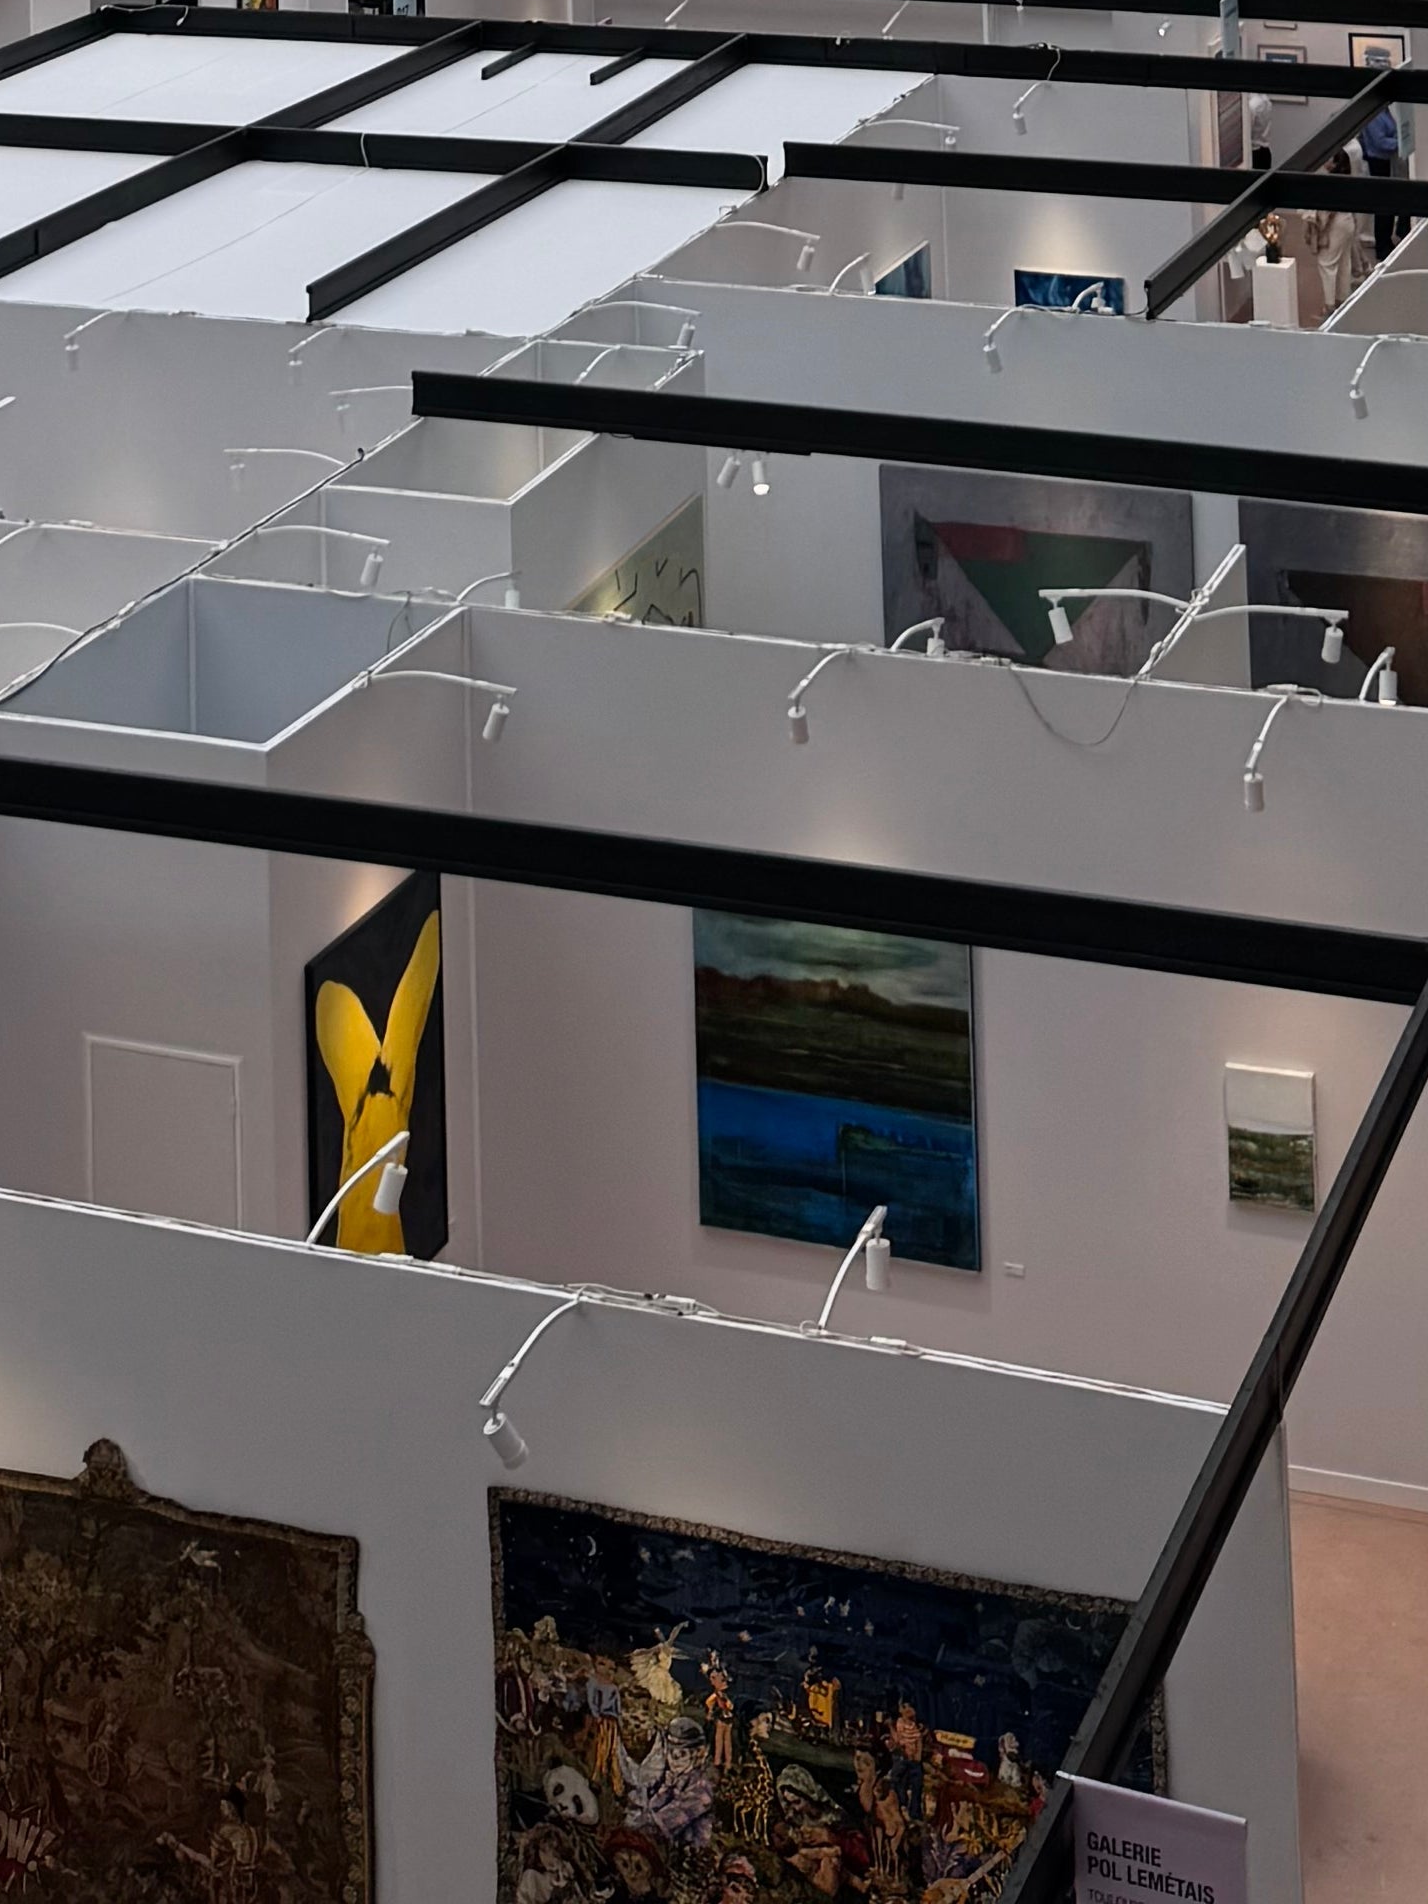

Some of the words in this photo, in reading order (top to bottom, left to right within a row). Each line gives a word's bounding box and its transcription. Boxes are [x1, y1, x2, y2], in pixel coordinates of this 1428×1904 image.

[1087, 1831, 1162, 1868] GALERIE
[1087, 1855, 1122, 1882] POL
[1127, 1864, 1215, 1904] LEMÉTAIS
